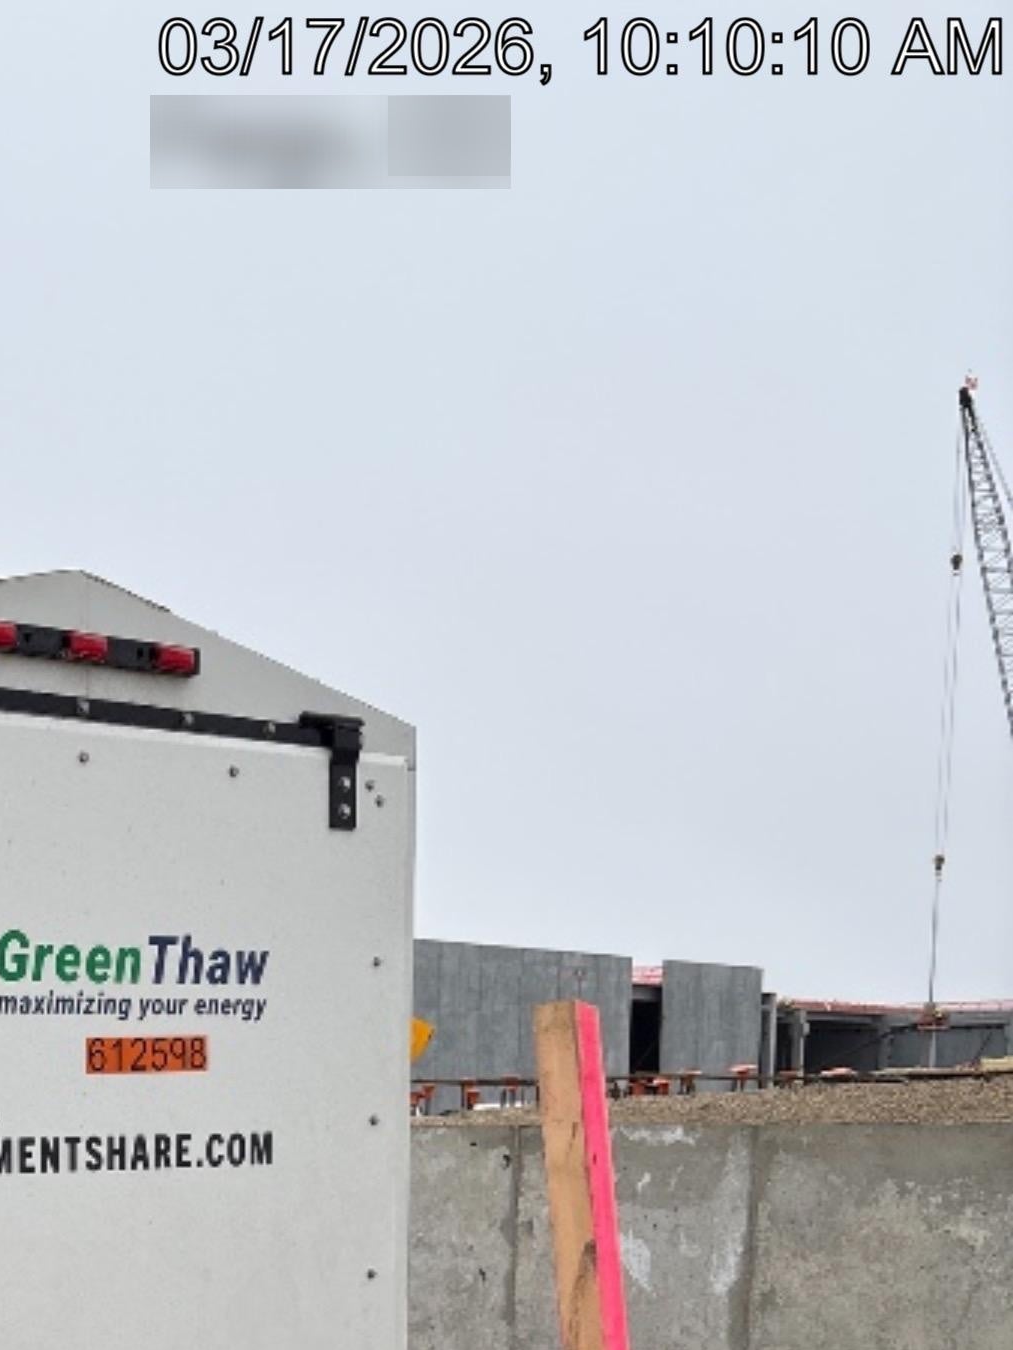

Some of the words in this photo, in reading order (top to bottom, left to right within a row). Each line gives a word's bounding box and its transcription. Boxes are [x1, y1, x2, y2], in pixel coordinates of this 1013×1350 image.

[138, 995, 186, 1020] your
[194, 995, 267, 1020] energy
[89, 1037, 206, 1072] 612598
